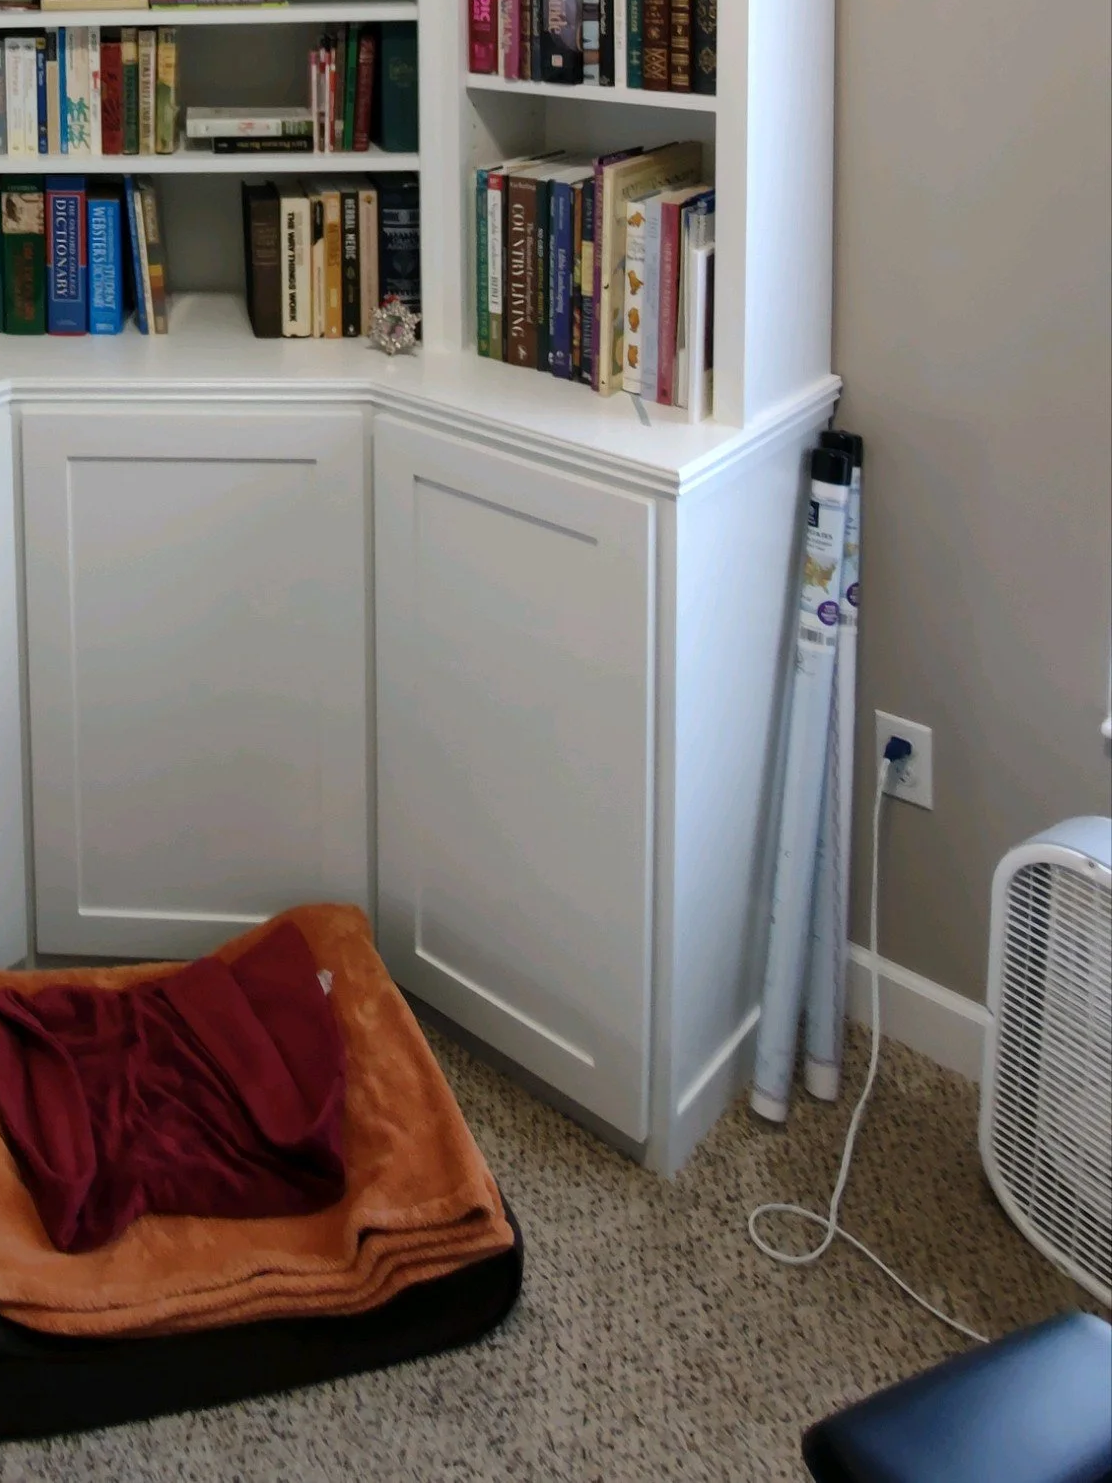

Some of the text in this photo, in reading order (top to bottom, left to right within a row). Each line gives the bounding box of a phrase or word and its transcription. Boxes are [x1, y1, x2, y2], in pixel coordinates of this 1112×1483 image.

[630, 0, 639, 34] SAILOR
[55, 199, 68, 296] DICTIONARY
[344, 198, 356, 260] HERBAL MEDIC
[526, 222, 534, 234] The
[287, 211, 298, 322] THE WAY THINGS WORK
[511, 203, 524, 337] COUNTRY LIVING
[556, 248, 567, 269] Edible
[105, 263, 117, 309] STUDENT
